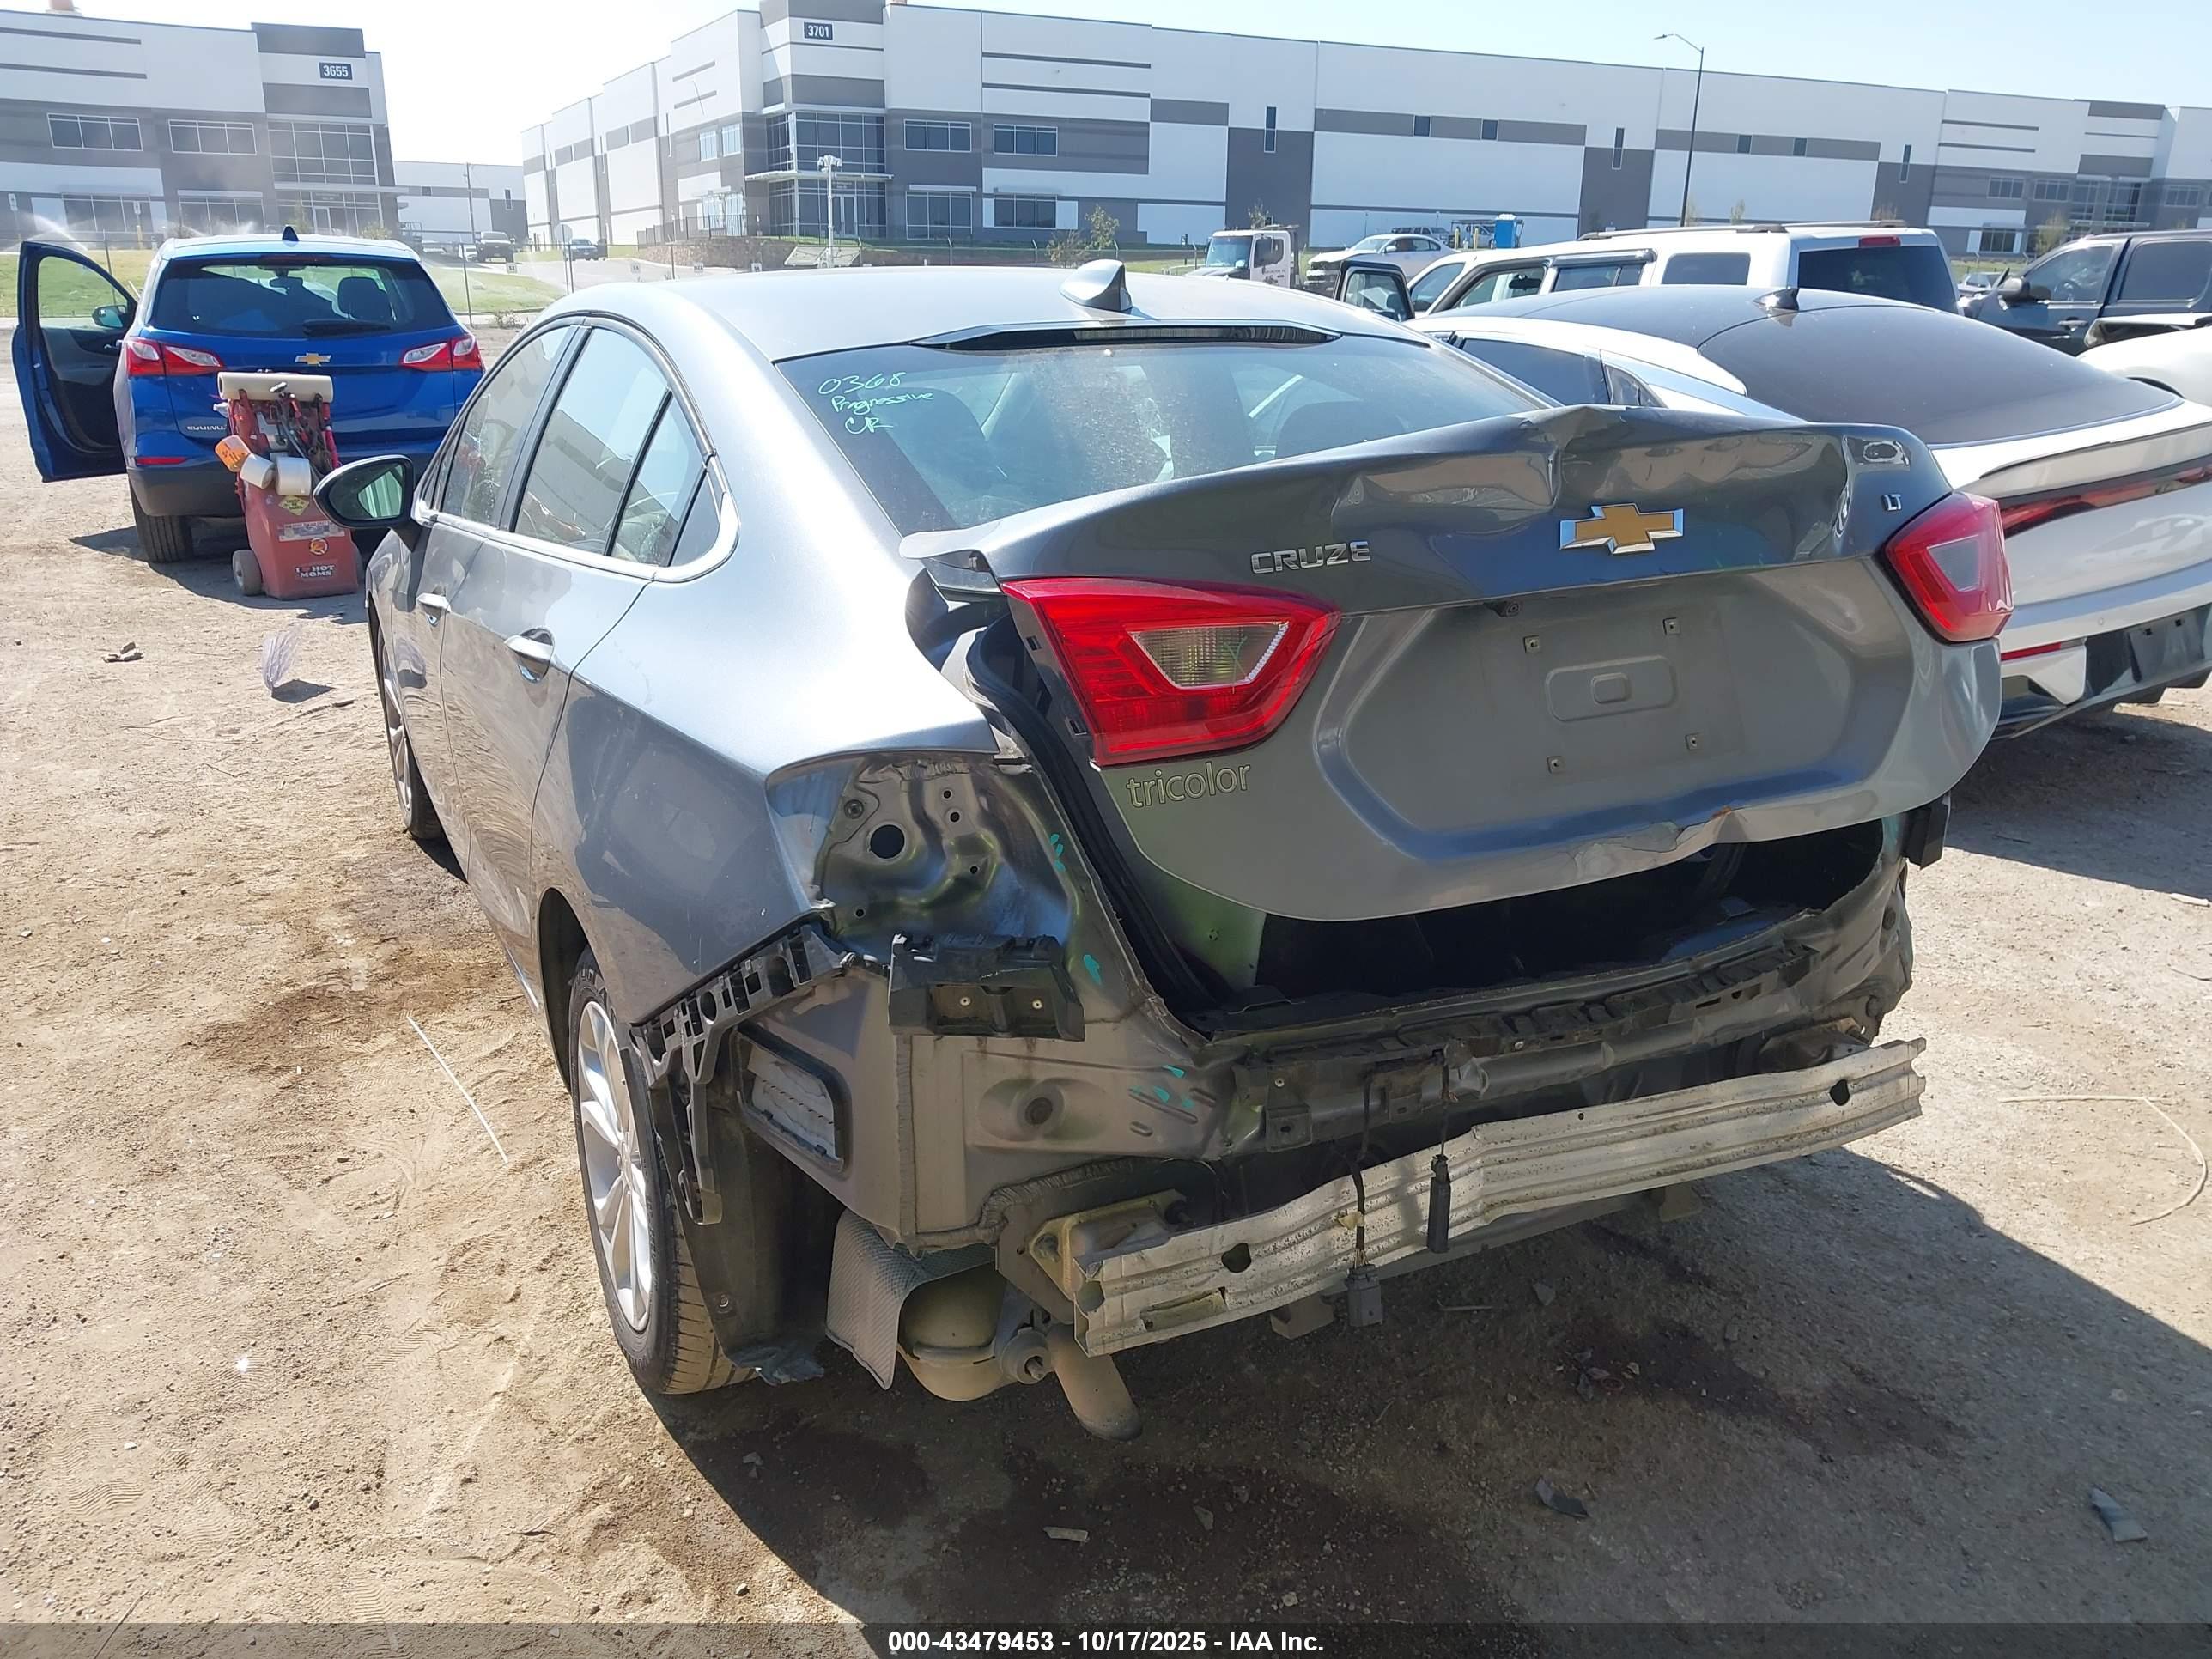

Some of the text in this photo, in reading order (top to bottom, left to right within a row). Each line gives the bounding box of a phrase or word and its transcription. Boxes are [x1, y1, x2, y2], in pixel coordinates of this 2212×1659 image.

[807, 25, 830, 38] 3701
[323, 64, 349, 77] 3655
[817, 372, 907, 395] 0368
[1882, 494, 1902, 511] LT
[1250, 540, 1371, 574] CRUZE
[1126, 761, 1251, 808] tricolor
